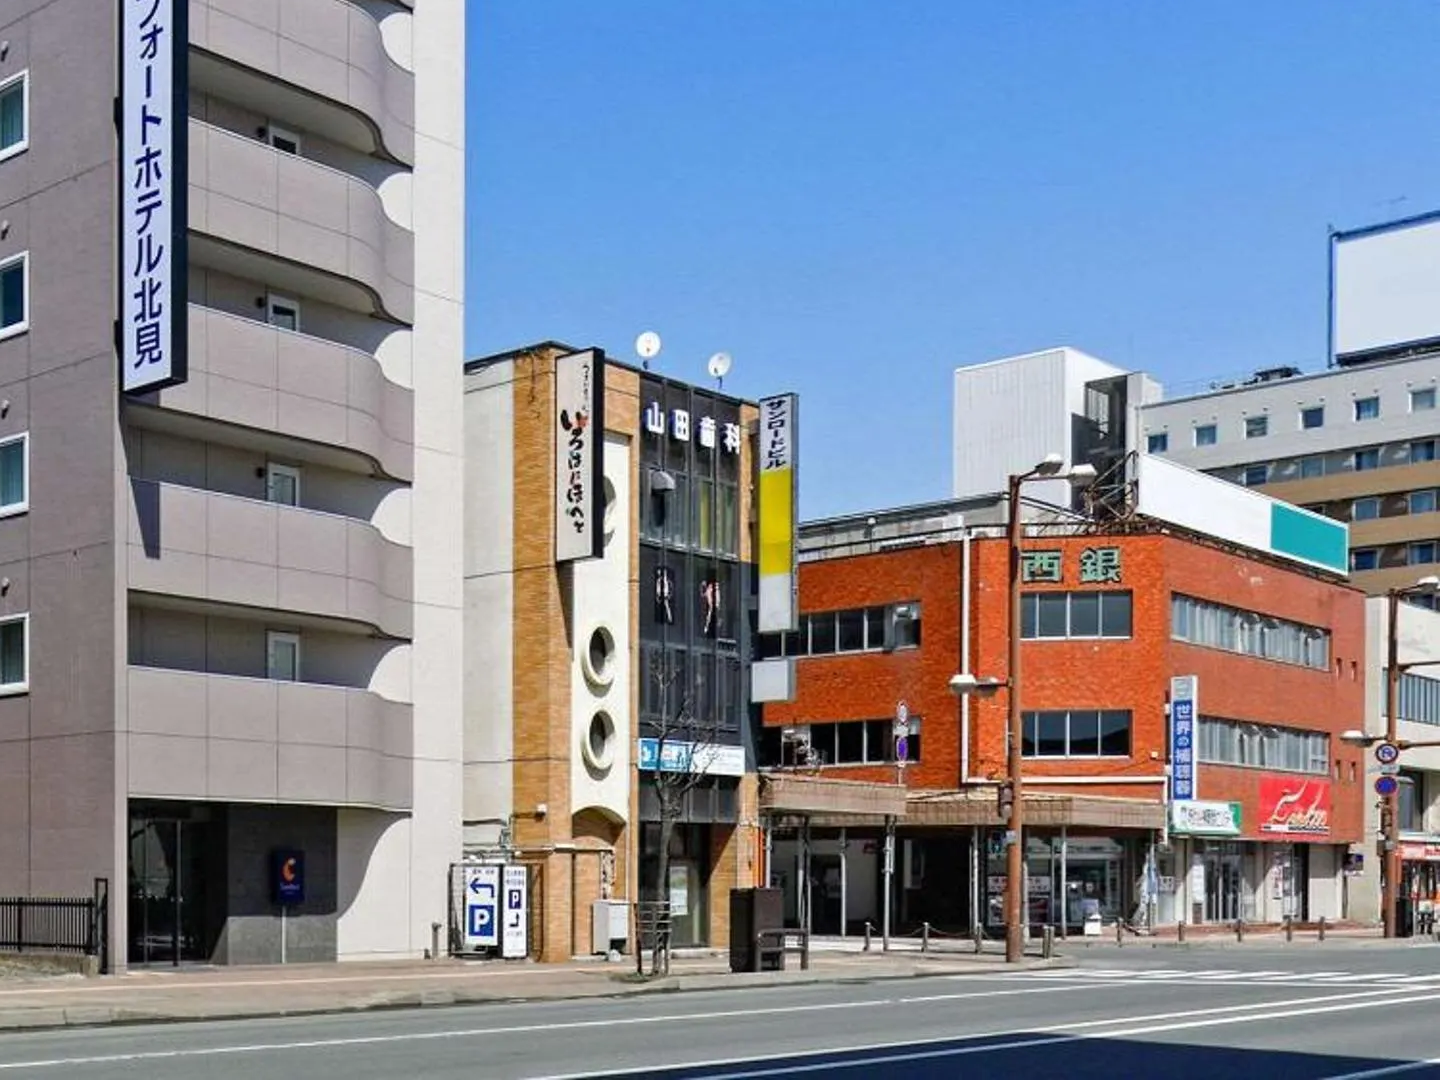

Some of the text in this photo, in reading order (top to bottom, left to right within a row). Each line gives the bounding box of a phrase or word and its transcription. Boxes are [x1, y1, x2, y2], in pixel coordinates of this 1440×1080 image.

[765, 400, 786, 469] サンロードビル
[1020, 547, 1121, 583] 西銀
[474, 909, 490, 933] P
